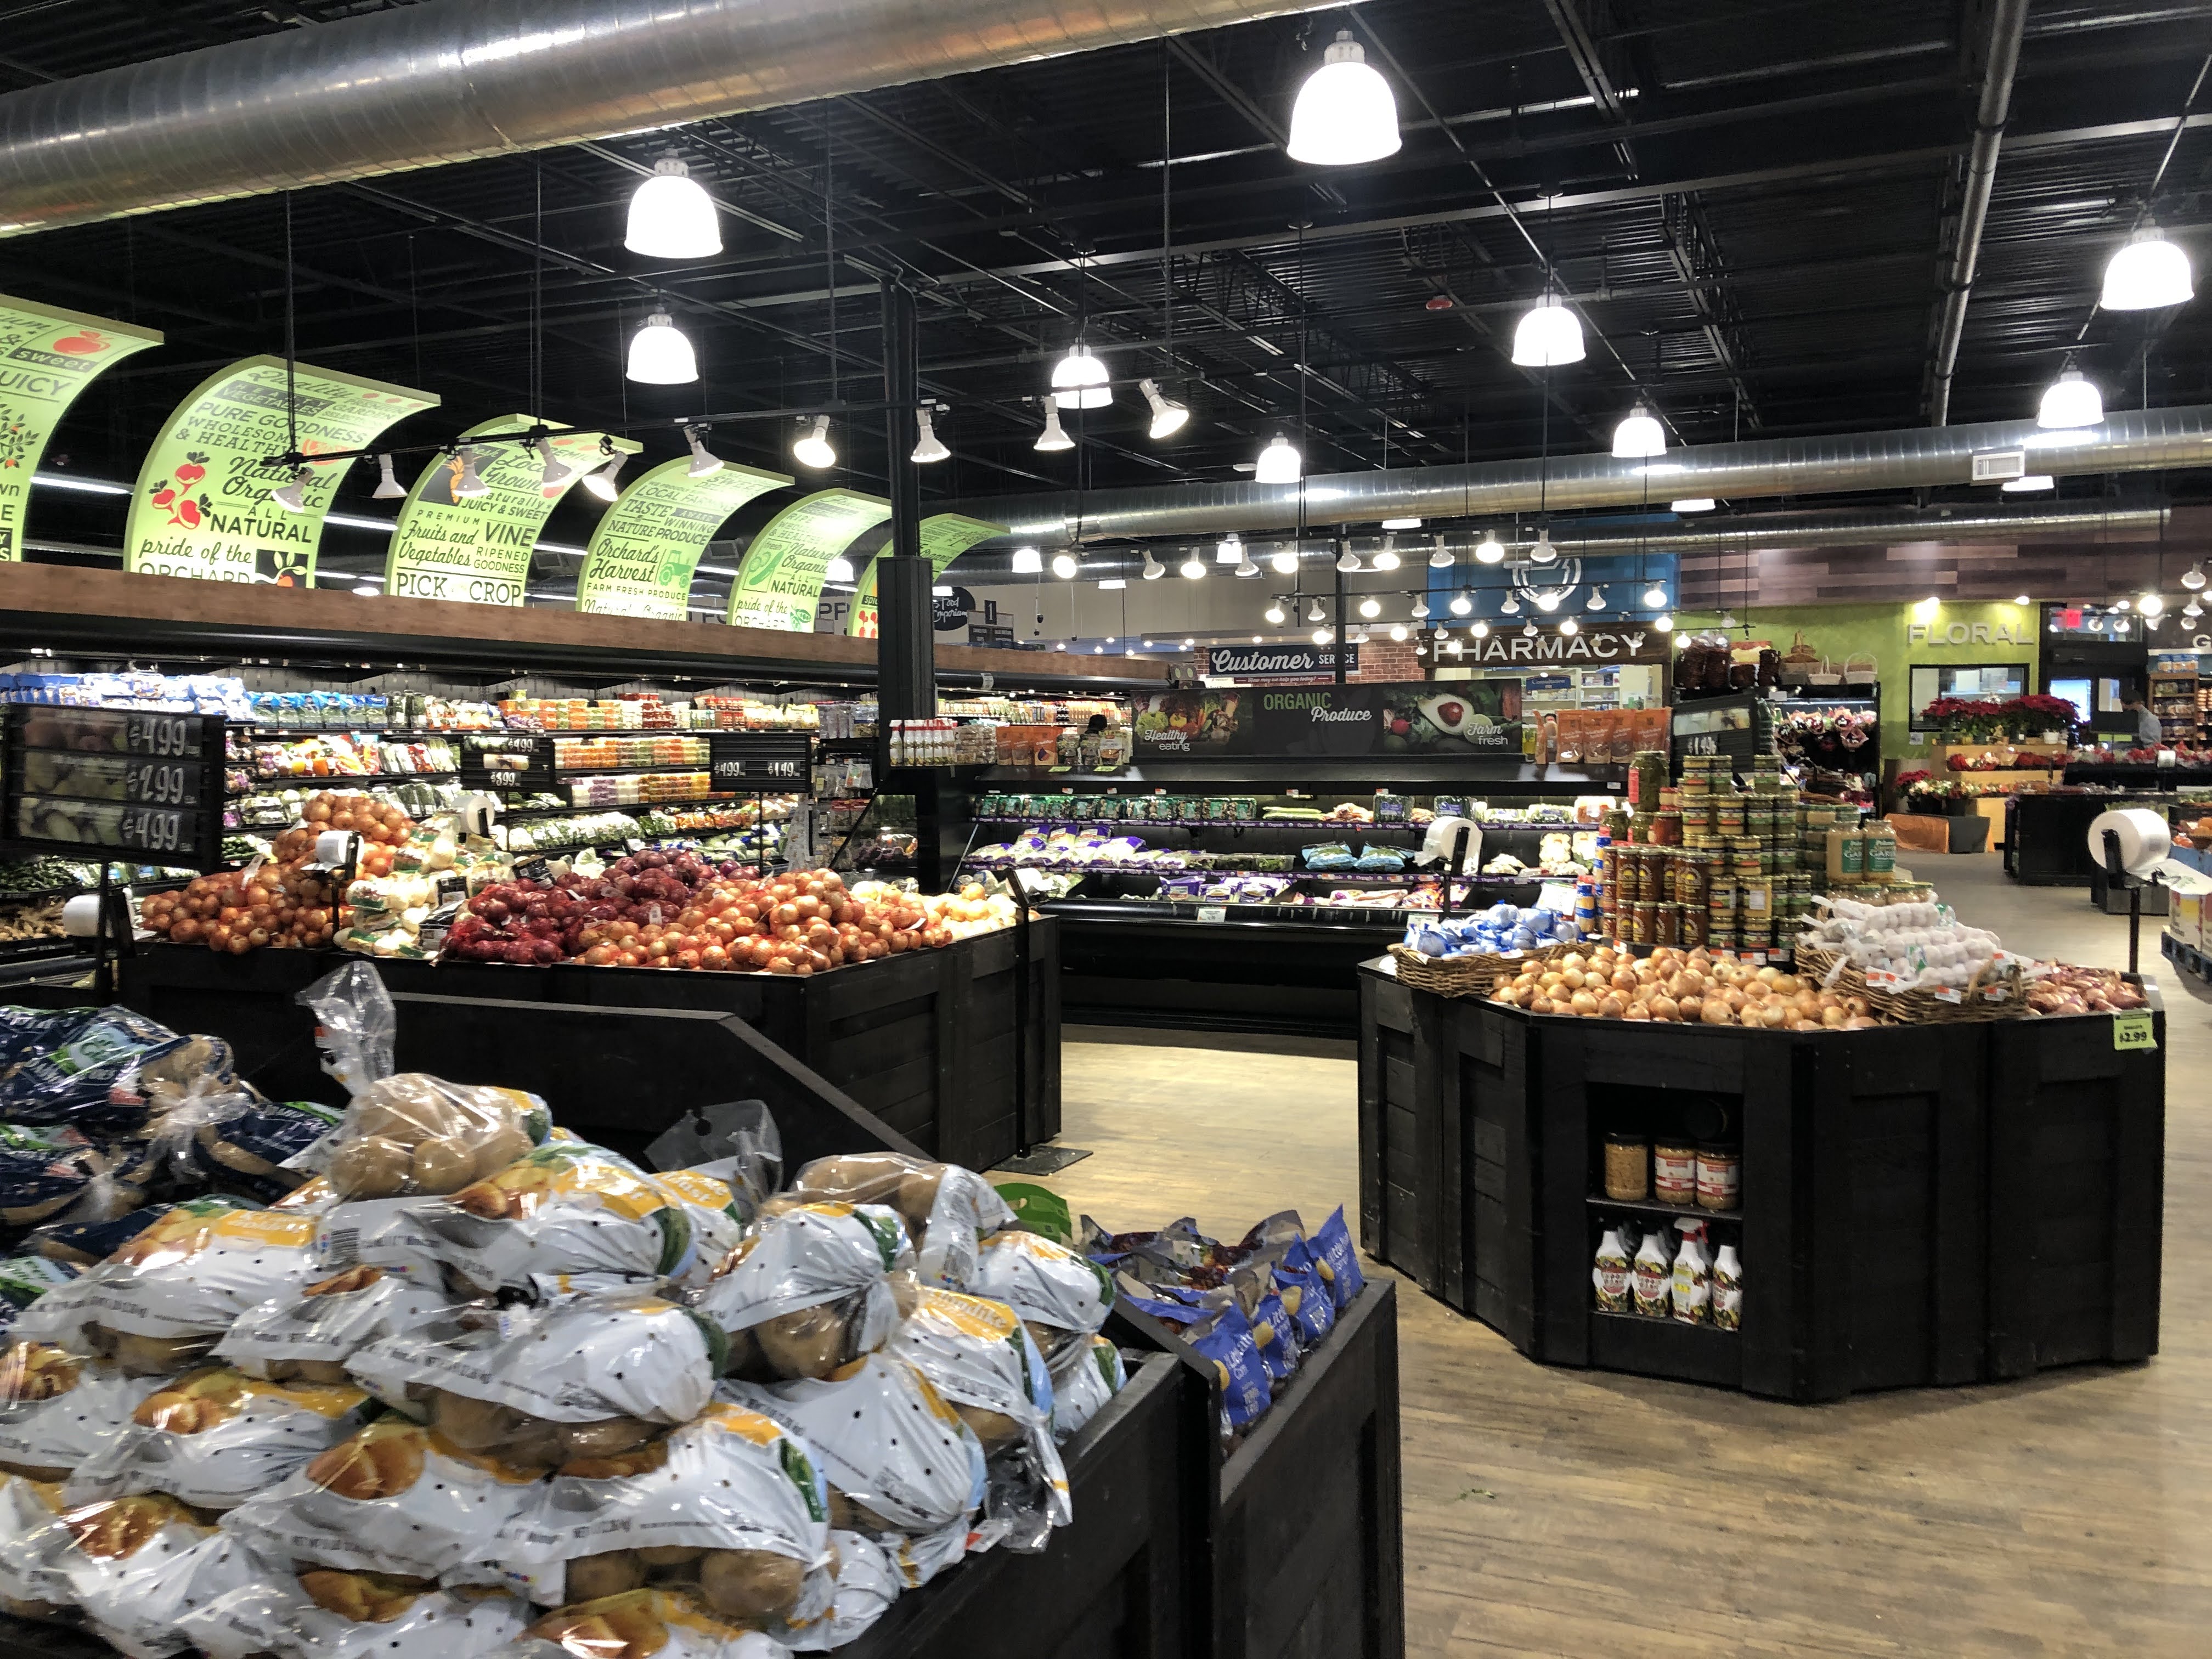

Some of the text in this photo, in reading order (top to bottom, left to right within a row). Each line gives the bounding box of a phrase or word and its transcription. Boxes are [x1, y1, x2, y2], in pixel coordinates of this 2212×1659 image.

[15, 349, 92, 371] sweet
[235, 383, 328, 407] HEATY
[195, 402, 368, 443] PURE GOODNESS
[175, 428, 190, 441] &
[495, 454, 545, 473] Loca
[549, 446, 609, 466] REMIUM
[227, 456, 338, 489] Natual
[486, 466, 543, 491] Grown
[222, 476, 324, 508] Orgic
[634, 485, 680, 501] LOCAL
[680, 493, 735, 512] FARG
[247, 505, 288, 521] ALL
[416, 509, 481, 526] PREMIUM
[461, 499, 548, 521] JUICY & SWEET
[623, 498, 674, 517] TASTE
[210, 513, 313, 544] NATURAL
[401, 520, 479, 545] Fruits and
[485, 521, 537, 549] VINE
[606, 519, 709, 546] NATURE PRODUCE
[664, 517, 716, 534] WINNING
[138, 536, 253, 566] pride of the
[398, 540, 529, 567] Vegetables RIPENED
[596, 538, 660, 564] Orchard's
[787, 542, 843, 561] Natural
[473, 559, 526, 574] GOODNESS
[589, 558, 657, 583] Harvest
[396, 572, 522, 606] PICK CROP
[770, 579, 819, 598] NATURAL
[789, 574, 809, 584] ALL
[586, 582, 686, 601] FARM FRESH PRODUCE
[735, 596, 788, 614] pride of the
[988, 602, 994, 620] 1
[1908, 622, 2035, 646] FLORAL
[1433, 631, 1646, 662] PHARMACY
[1211, 649, 1355, 673] Customer SERCE
[1263, 692, 1332, 711] ORGANIC
[1311, 706, 1373, 724] Produce
[1144, 729, 1189, 744] Healthy
[1466, 721, 1504, 737] Farm
[1158, 741, 1191, 752] eating
[1477, 735, 1509, 746] fresh
